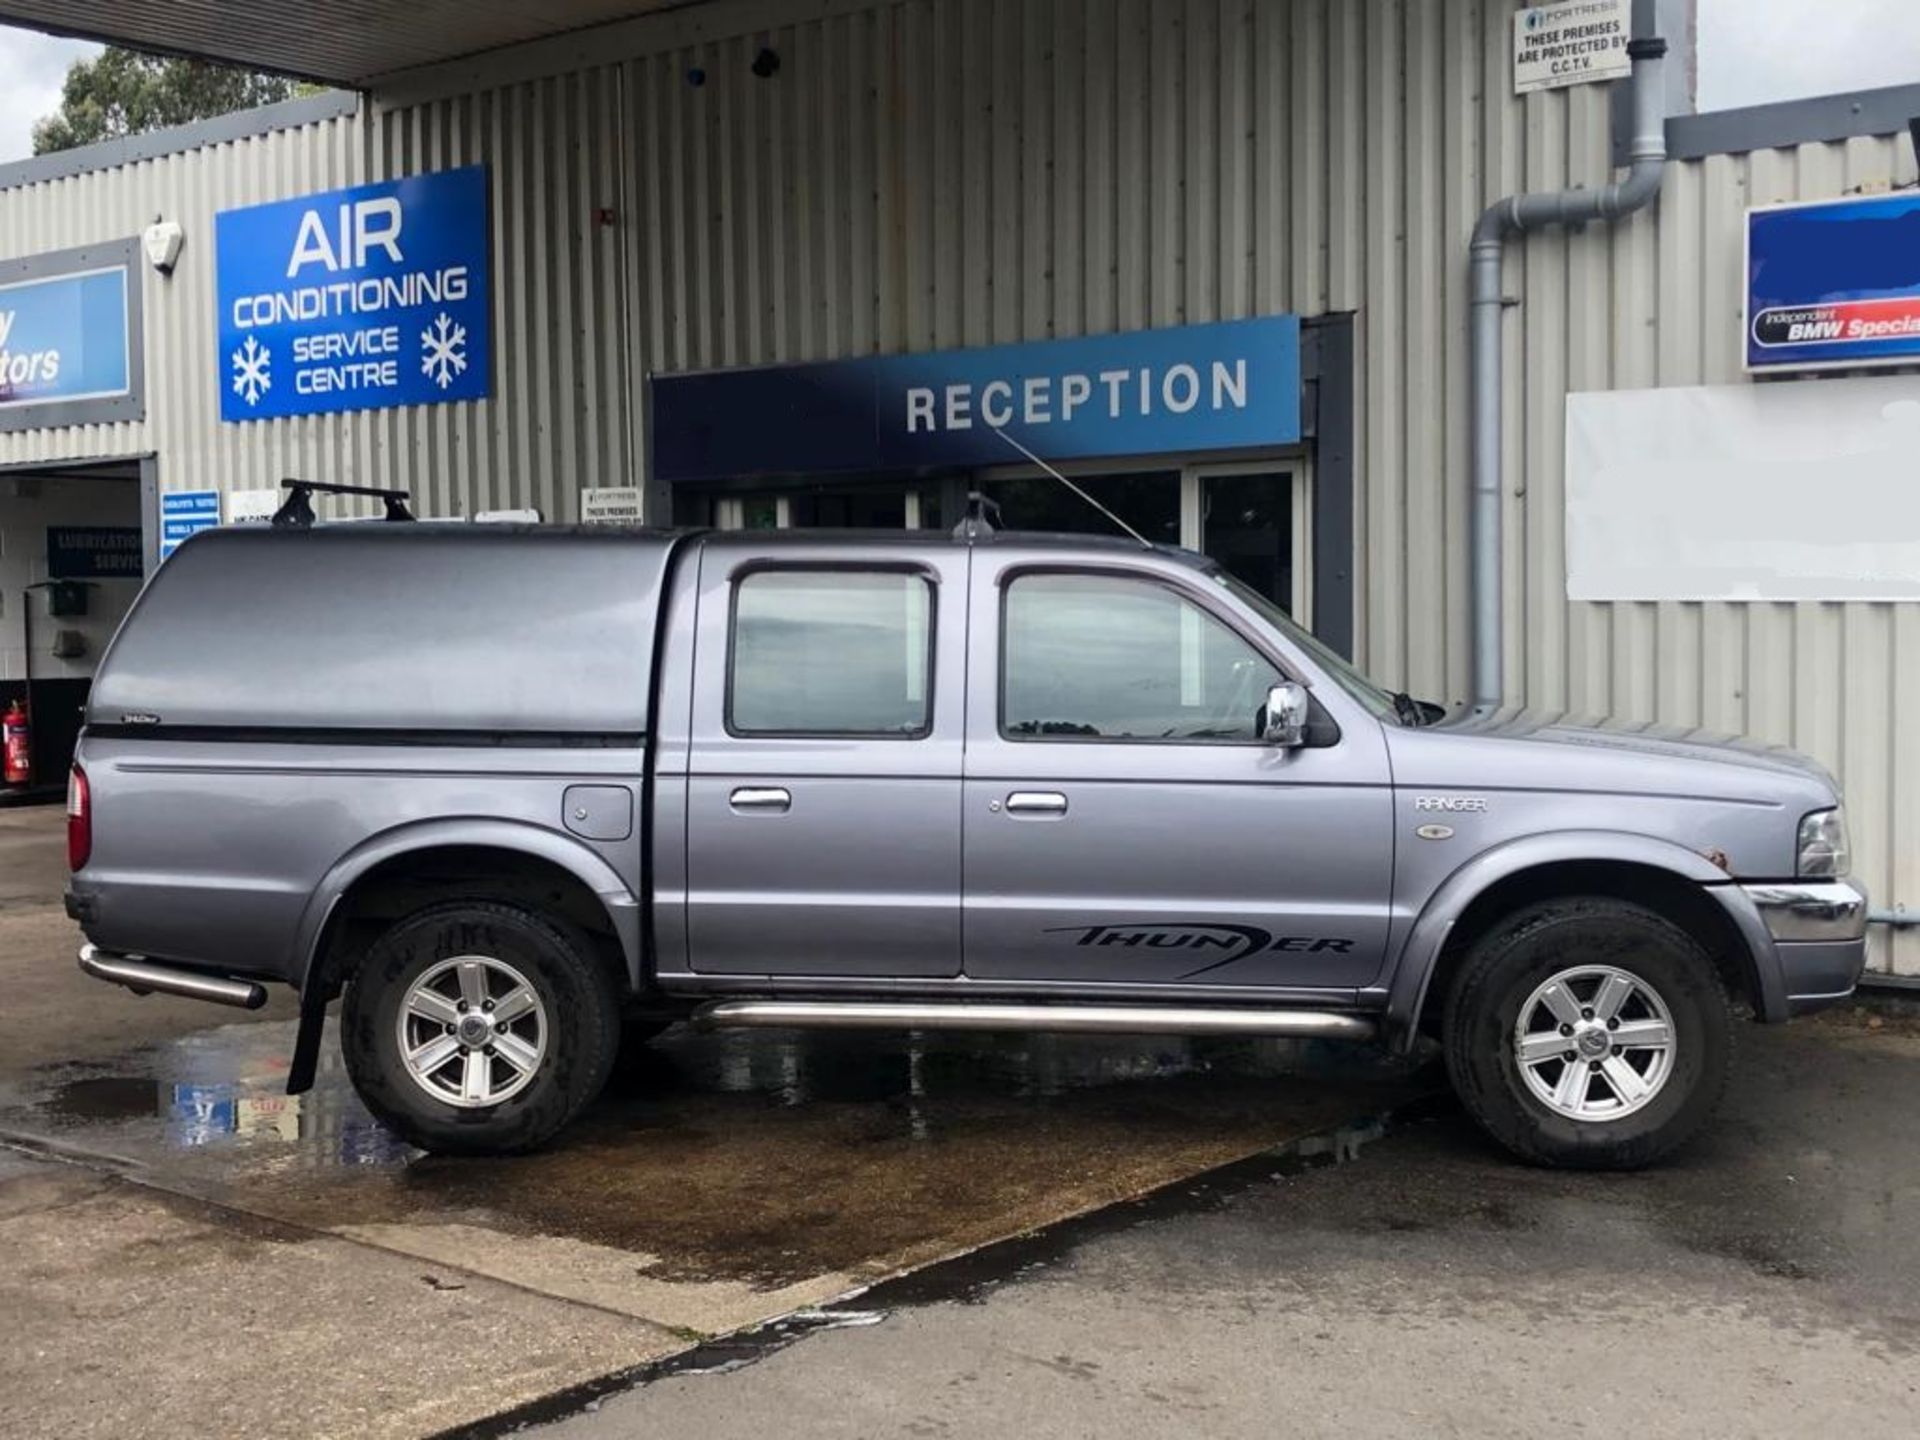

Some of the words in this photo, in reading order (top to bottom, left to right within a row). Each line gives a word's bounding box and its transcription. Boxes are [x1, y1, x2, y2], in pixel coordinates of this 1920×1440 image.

[1518, 50, 1540, 64] ARE
[1542, 38, 1609, 59] PROTECTED
[1612, 35, 1627, 48] BY
[1524, 30, 1560, 47] THESE
[1563, 20, 1620, 40] PREMISES
[286, 196, 404, 278] AIR
[233, 266, 468, 329] CONDITIONING
[293, 326, 399, 362] SERVICE
[1788, 320, 1844, 341] BMW
[295, 360, 398, 394] CENTRE
[907, 359, 1247, 433] RECEPTION
[1415, 796, 1487, 813] RANGER
[1043, 922, 1355, 980] THUNDER
